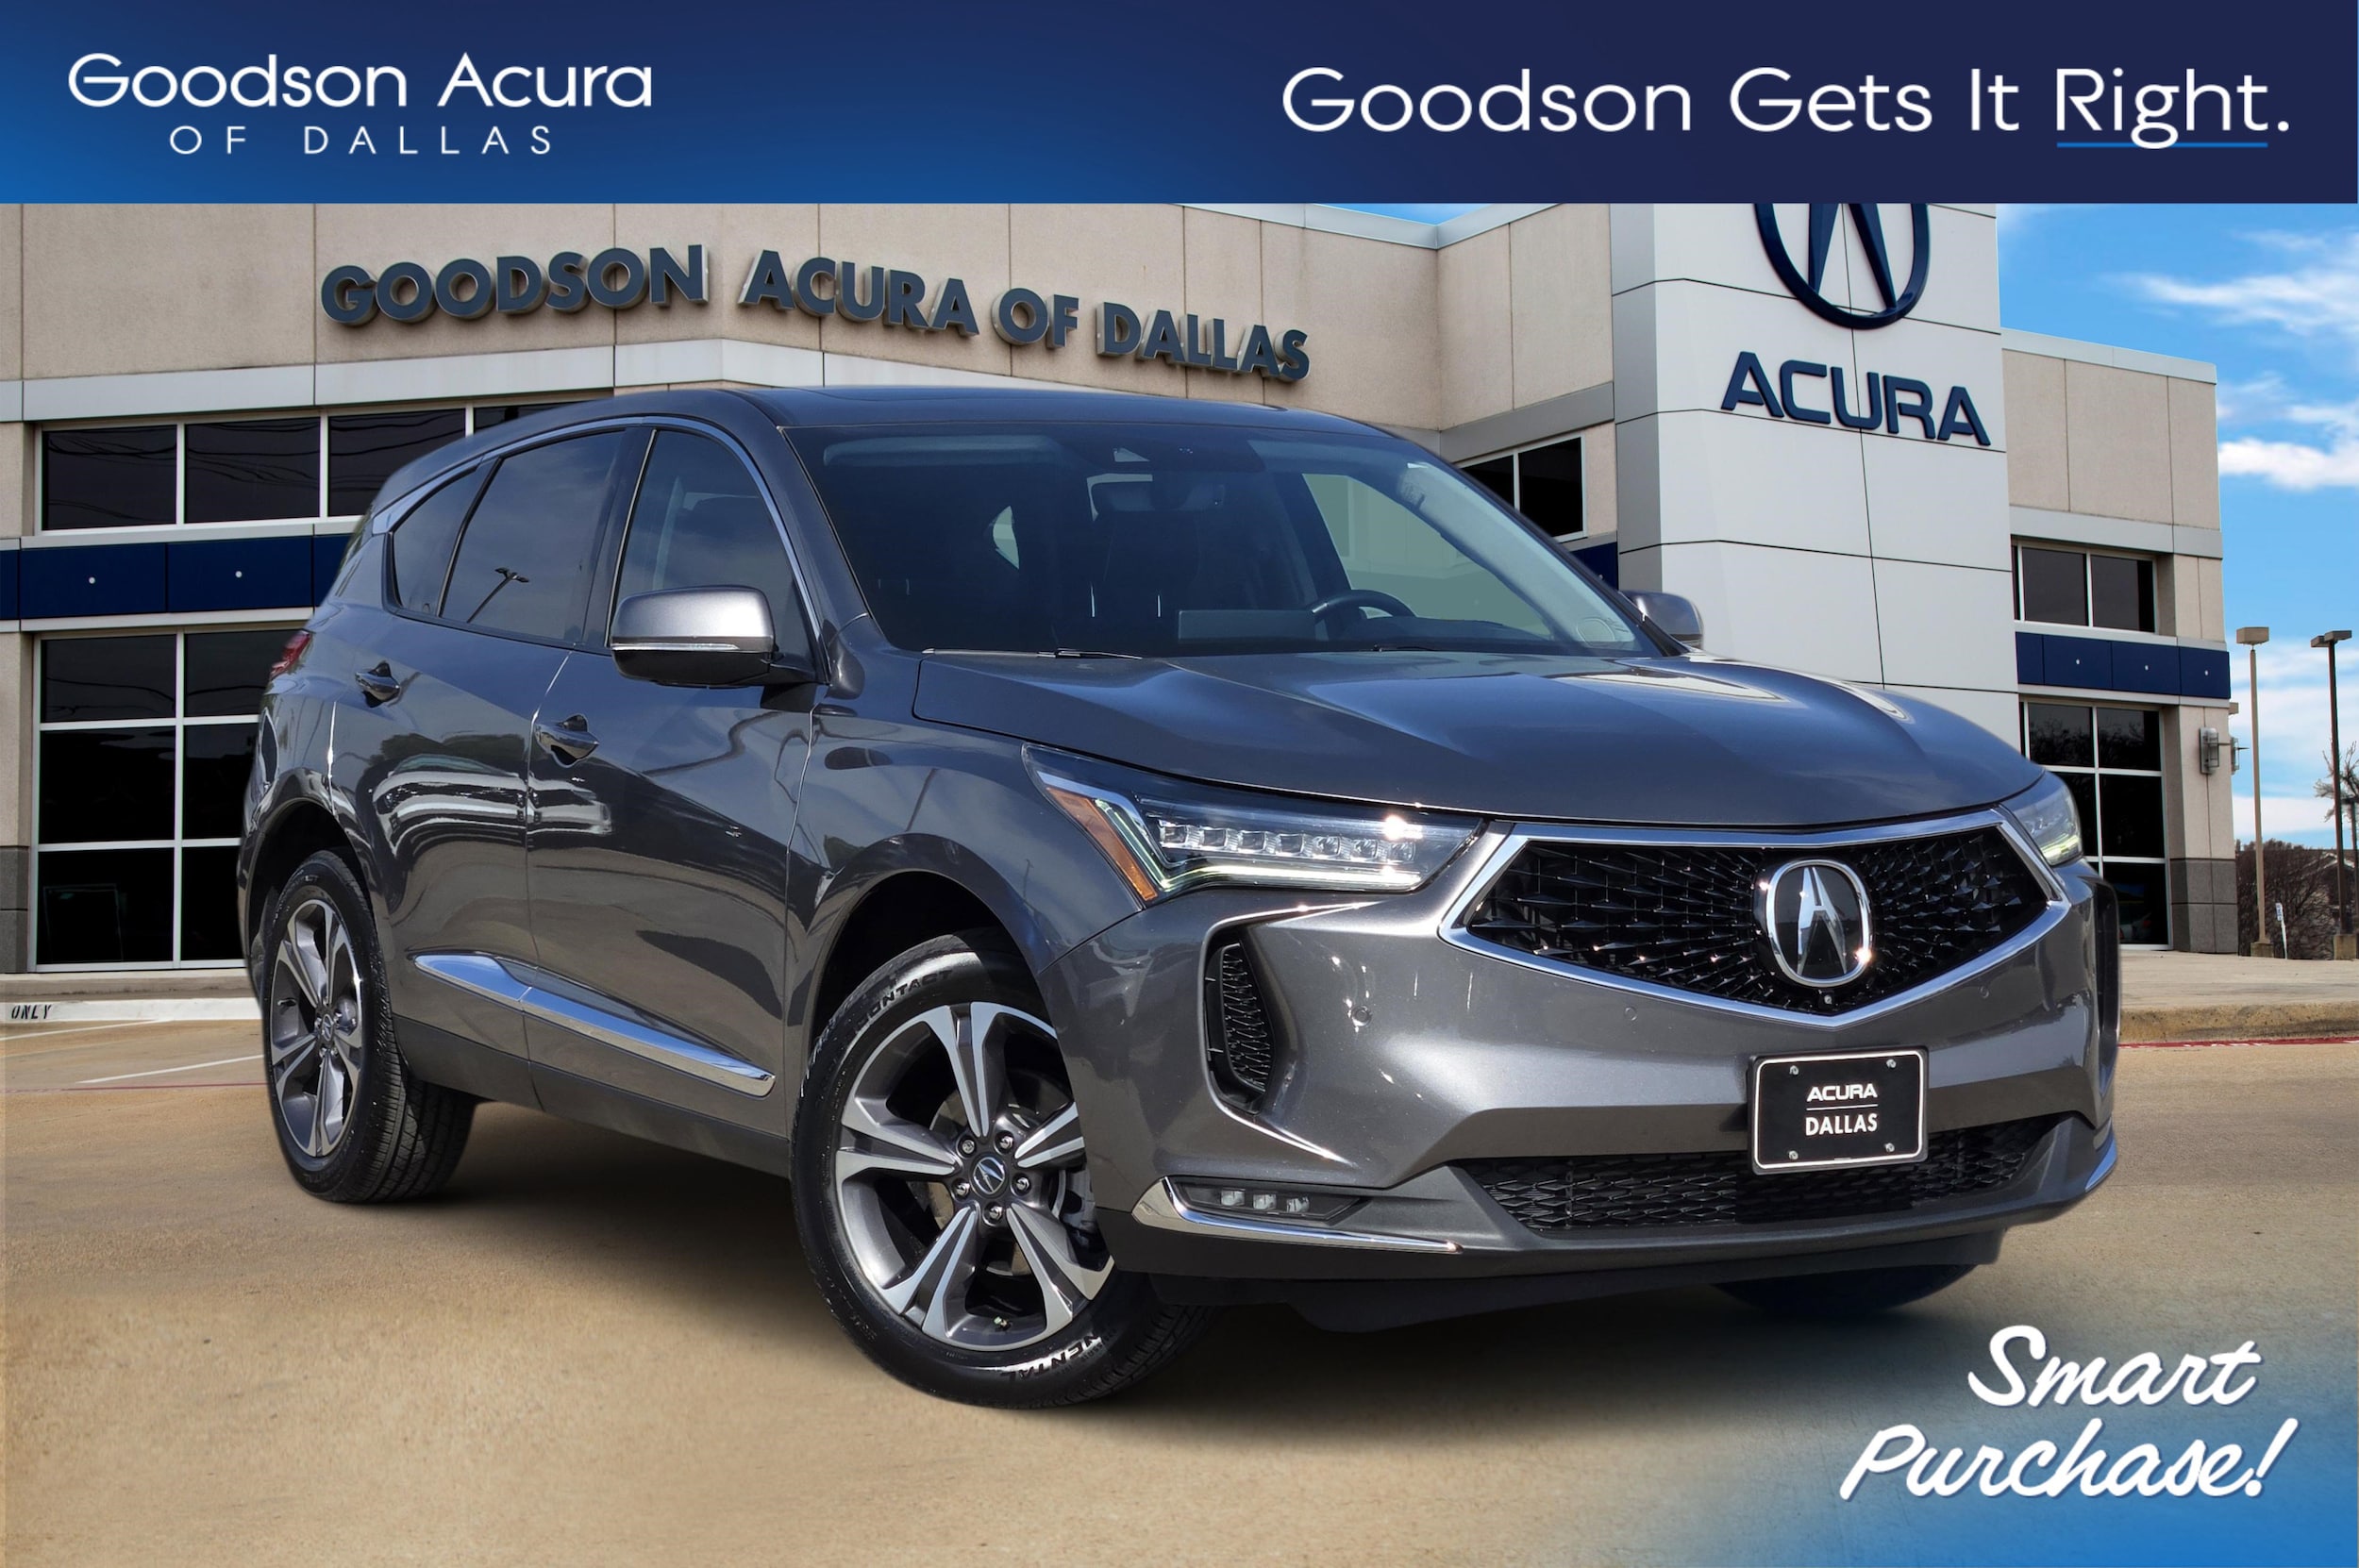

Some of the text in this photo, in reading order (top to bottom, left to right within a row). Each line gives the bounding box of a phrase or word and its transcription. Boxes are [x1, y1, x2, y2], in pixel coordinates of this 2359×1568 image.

[321, 244, 1311, 382] GOODSON ACURA OF DALLAS
[1720, 351, 1991, 446] ACURA
[10, 1004, 52, 1020] ONLY
[1807, 1083, 1878, 1102] ACURA
[1805, 1113, 1878, 1136] DALLAS
